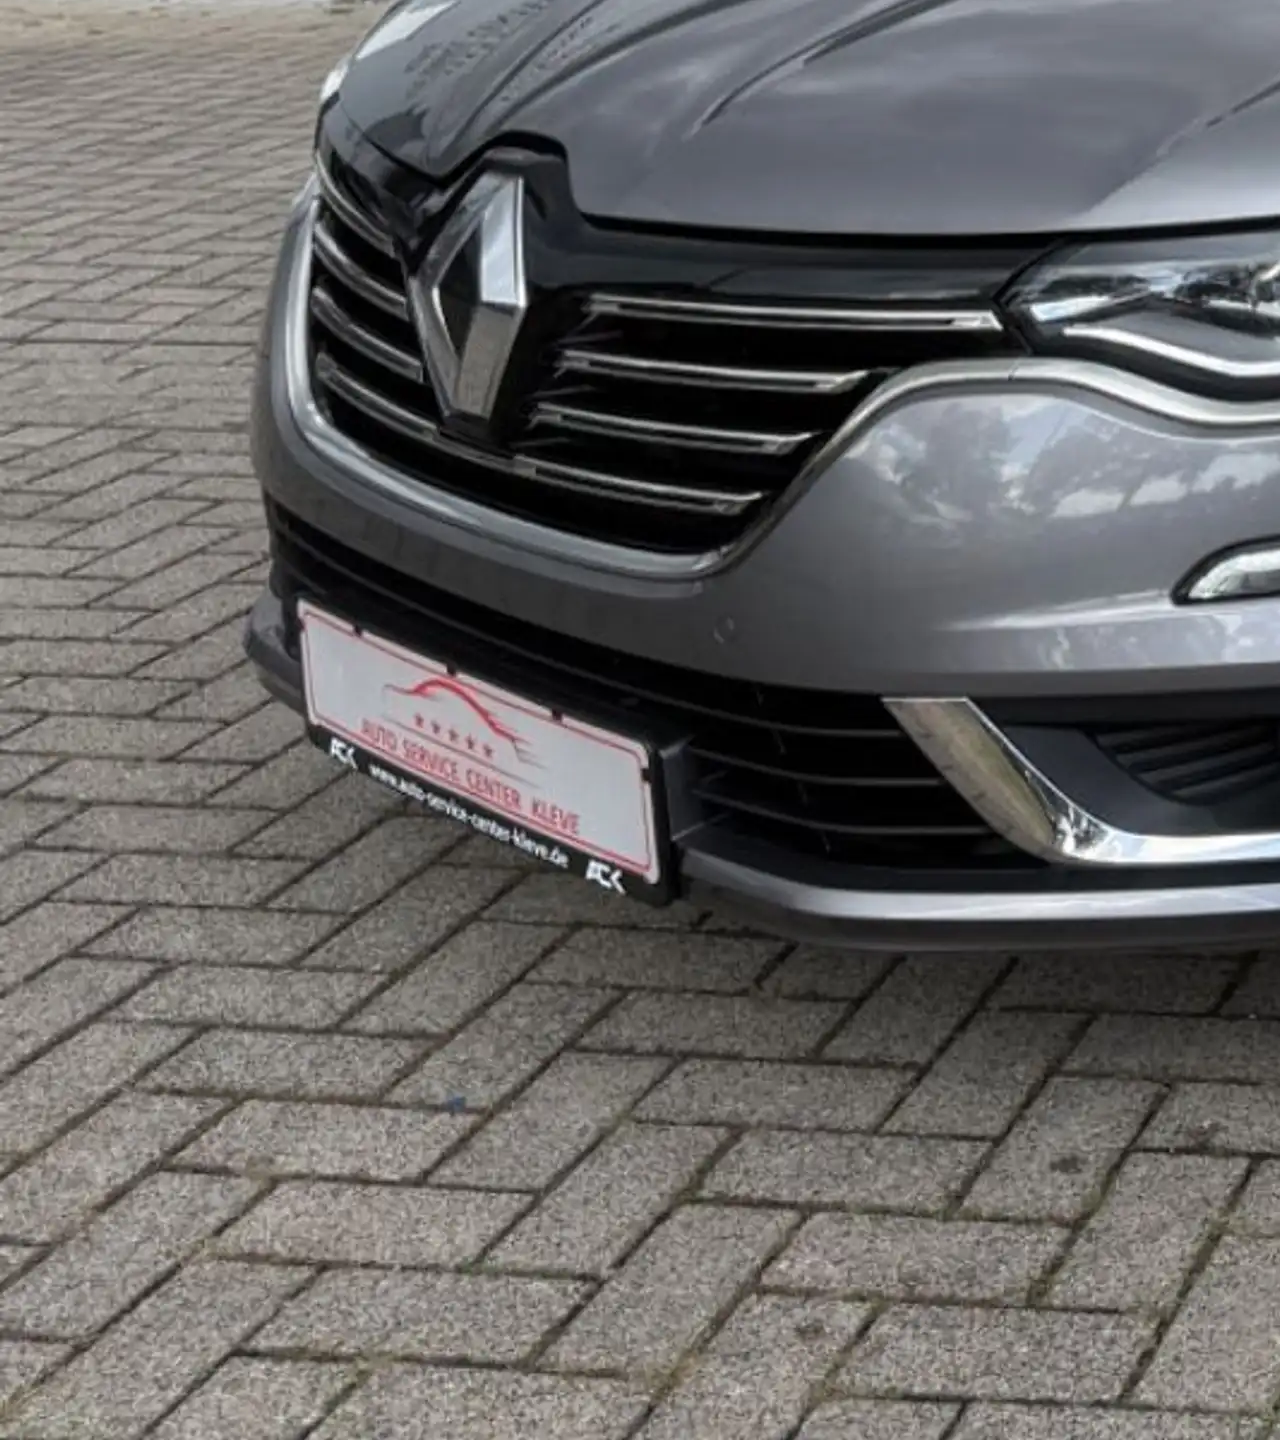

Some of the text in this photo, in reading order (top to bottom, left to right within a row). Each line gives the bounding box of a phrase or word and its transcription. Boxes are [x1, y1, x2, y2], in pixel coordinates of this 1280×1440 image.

[361, 717, 397, 751] AUTO
[403, 739, 459, 781] SERVICE
[466, 768, 522, 810] CENTER
[531, 796, 581, 836] KLEVE
